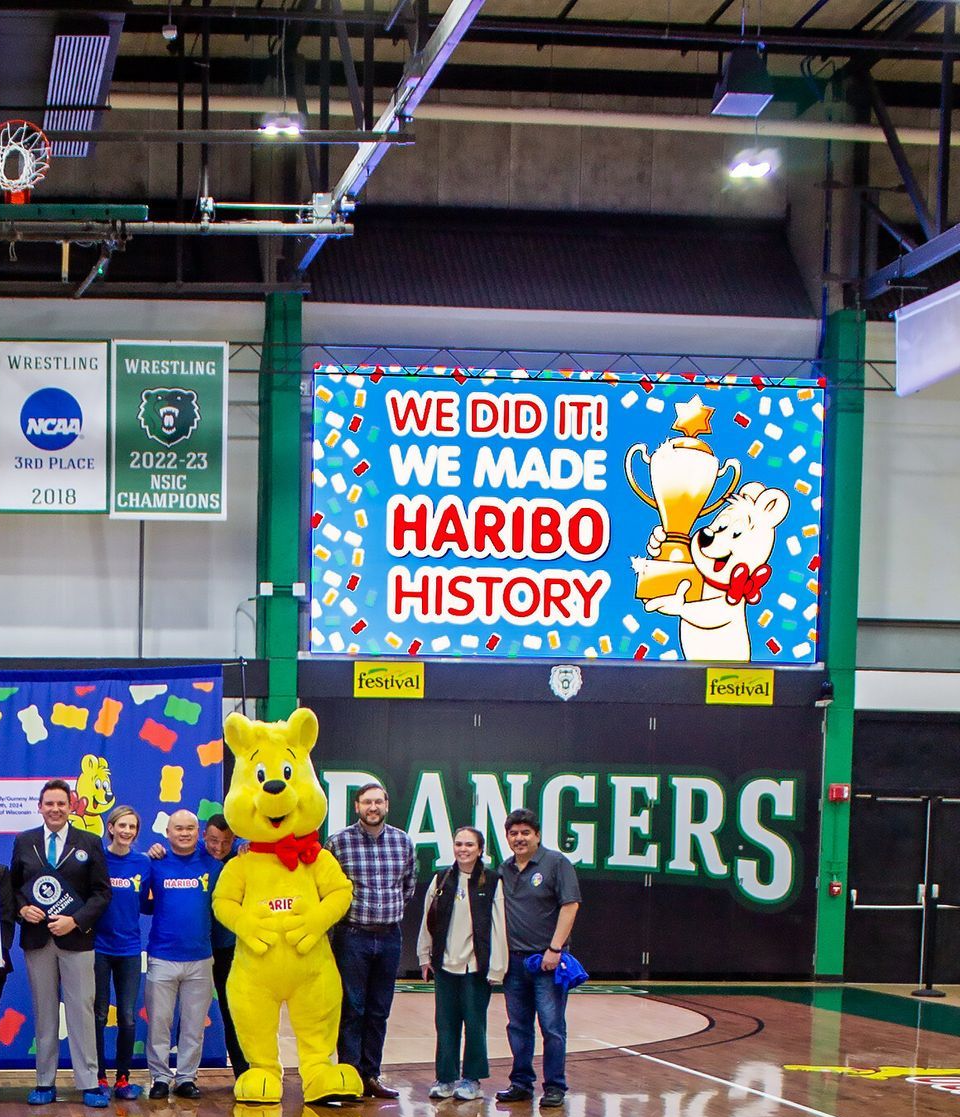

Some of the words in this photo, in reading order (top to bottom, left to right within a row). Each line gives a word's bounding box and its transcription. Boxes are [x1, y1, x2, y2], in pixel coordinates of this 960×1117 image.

[7, 355, 98, 370] WRESTLING
[124, 359, 216, 376] WRESTLING
[388, 394, 457, 434] WE
[469, 395, 544, 436] DID
[557, 397, 605, 439] IT!
[26, 418, 81, 435] NCAA
[14, 456, 43, 469] 3RD
[49, 456, 95, 469] PLACE
[129, 452, 208, 469] 2022-23
[389, 444, 461, 487] WE
[473, 446, 607, 490] MADE
[150, 474, 187, 490] NSIC
[32, 488, 76, 505] 2018
[117, 492, 220, 509] CHAMPIONS
[390, 500, 607, 558] HARIBO
[392, 571, 606, 622] HISTORY
[358, 672, 420, 689] festival
[710, 679, 769, 696] festival
[110, 878, 130, 888] RIBO
[164, 878, 199, 889] HARIBO
